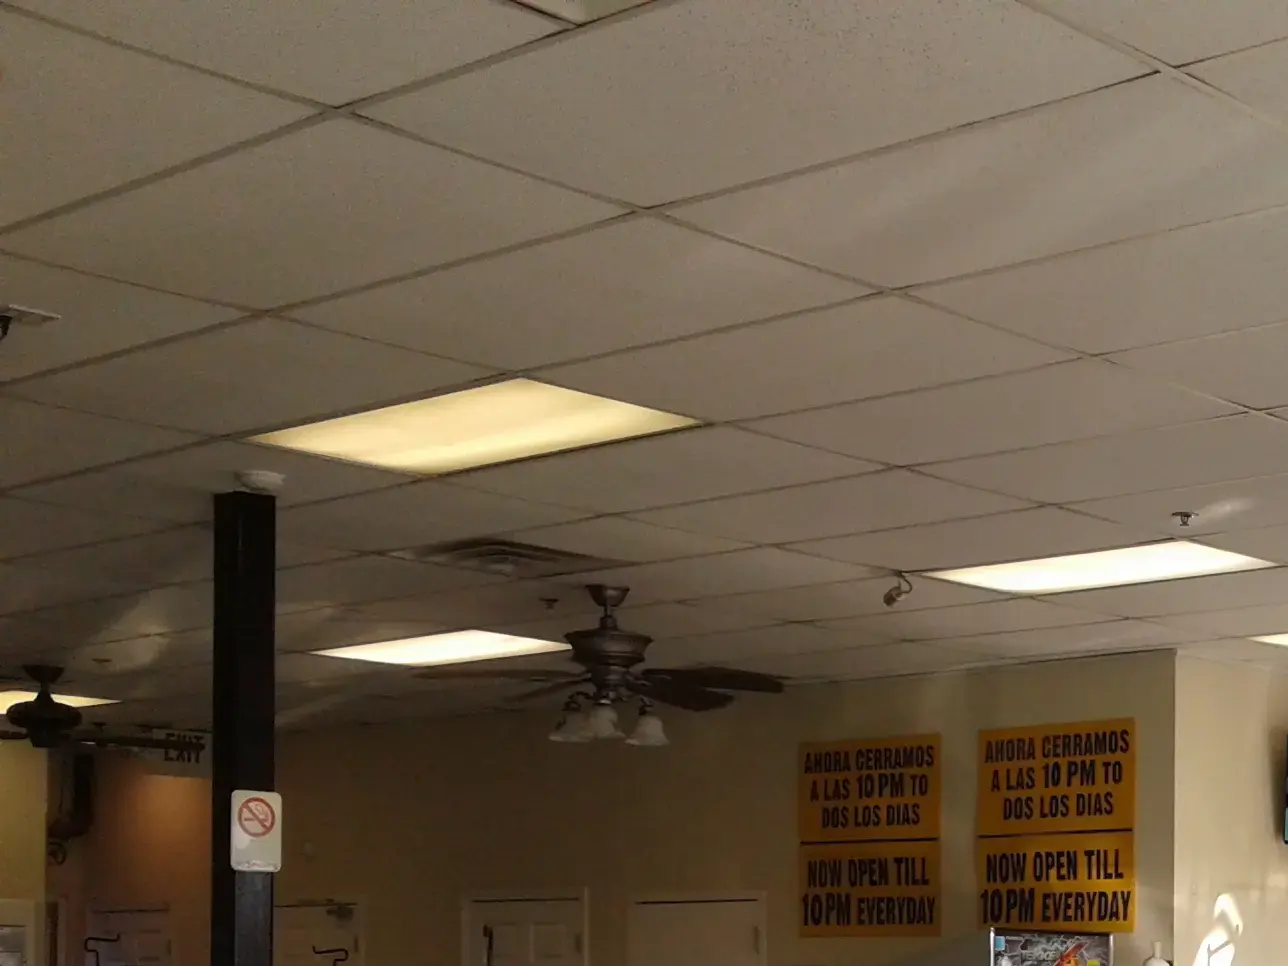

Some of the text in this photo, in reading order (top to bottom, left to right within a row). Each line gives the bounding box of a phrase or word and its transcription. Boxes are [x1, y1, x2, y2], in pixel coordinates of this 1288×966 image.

[804, 745, 934, 774] AHORA CERRAMOS
[985, 729, 1130, 763] AHORA CERRAMOS
[810, 779, 819, 801] A
[823, 778, 850, 801] LAS
[910, 774, 928, 796] TO
[990, 760, 1122, 792] A LAS 10 PM TO
[822, 803, 920, 828] DOS LOS DIAS
[1003, 791, 1113, 820] DOS LOS DIAS
[808, 857, 930, 888] NOW OPEN TILL
[986, 849, 1124, 883] NOW OPEN TILL
[857, 896, 935, 925] EVERYDAY
[1042, 891, 1131, 923] EVERYDAY
